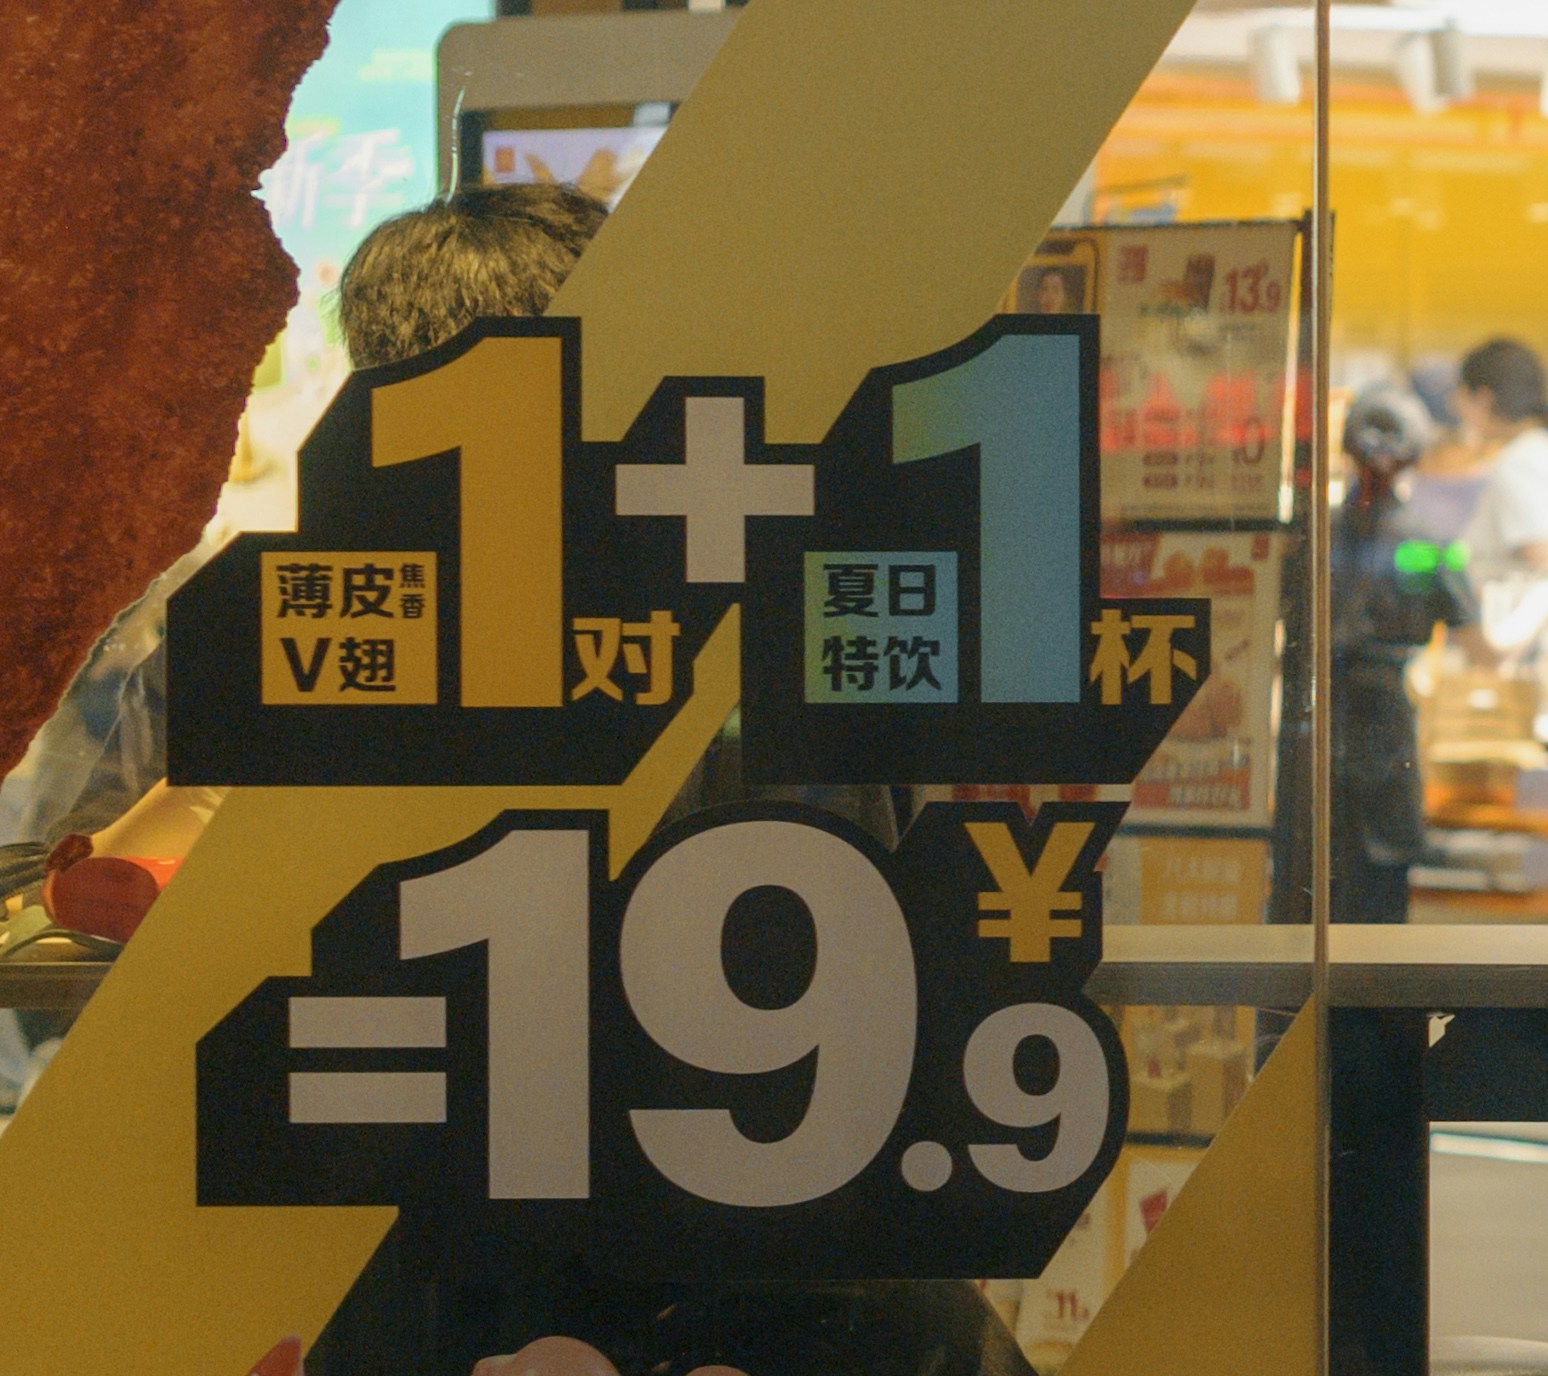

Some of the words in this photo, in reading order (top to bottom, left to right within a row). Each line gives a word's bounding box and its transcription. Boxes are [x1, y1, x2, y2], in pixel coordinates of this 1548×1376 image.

[821, 562, 940, 619] 夏日
[280, 636, 398, 692] V翅
[821, 634, 943, 693] 特饮
